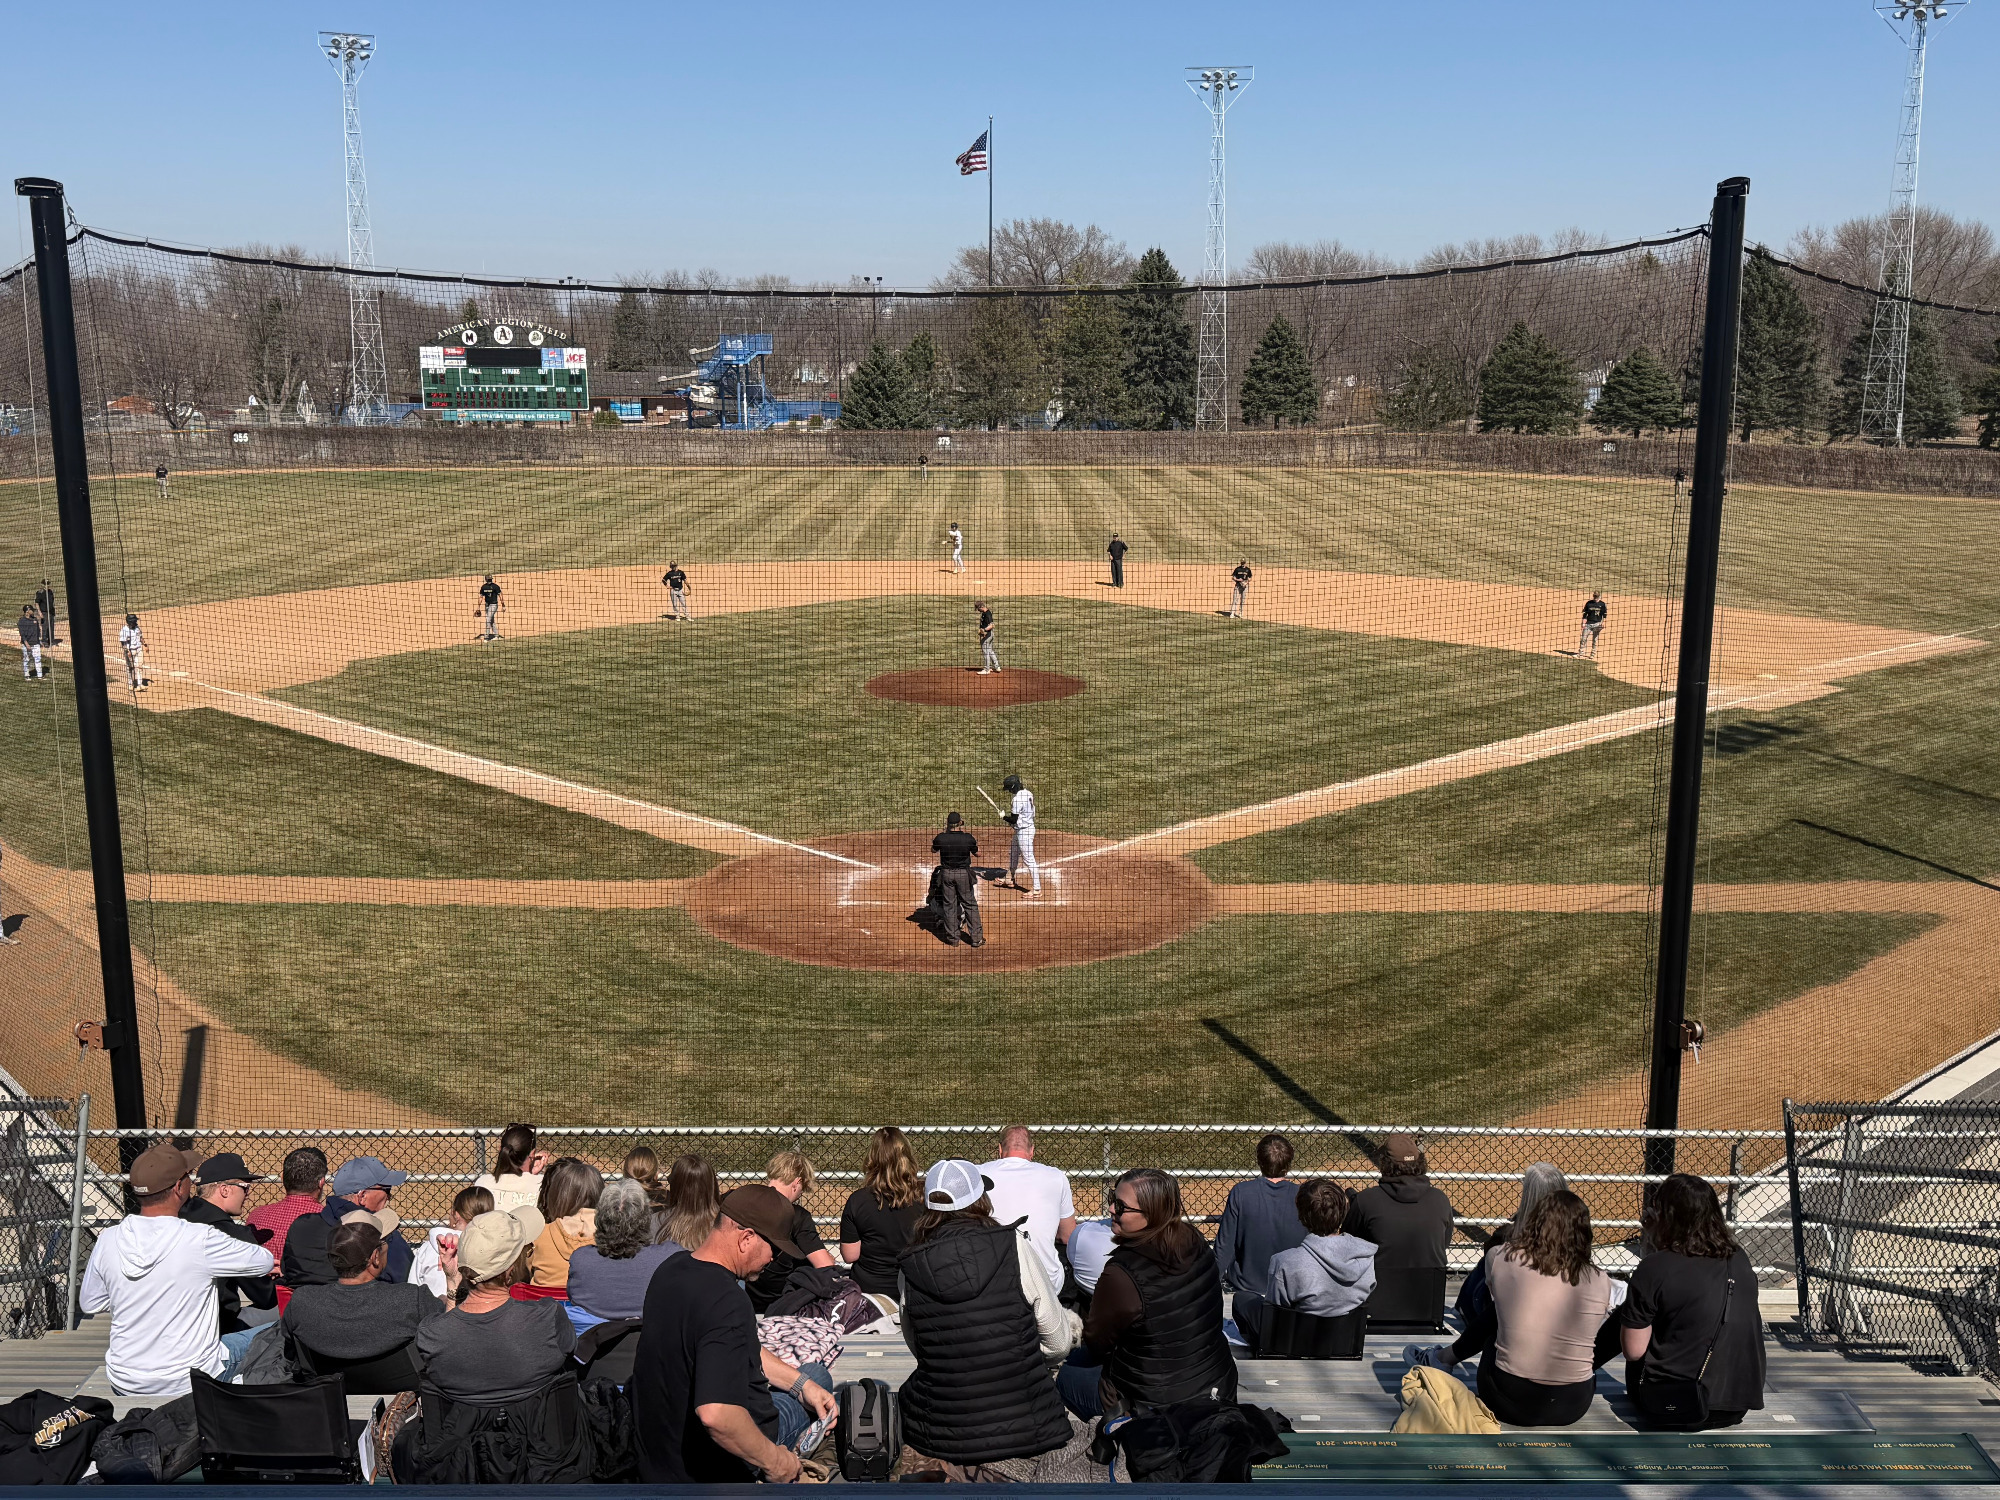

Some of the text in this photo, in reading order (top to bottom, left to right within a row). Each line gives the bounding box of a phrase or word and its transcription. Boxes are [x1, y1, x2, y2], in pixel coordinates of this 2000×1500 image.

[437, 318, 490, 340] AMERICAN
[495, 317, 534, 329] LEGION
[537, 324, 567, 340] FIELD
[565, 352, 585, 364] ACE
[233, 432, 249, 443] 355
[937, 436, 951, 446] 375
[1486, 1463, 1507, 1471] Jerry
[1820, 1463, 1973, 1471] MARSHALL BASEBALL HALL OF FAME
